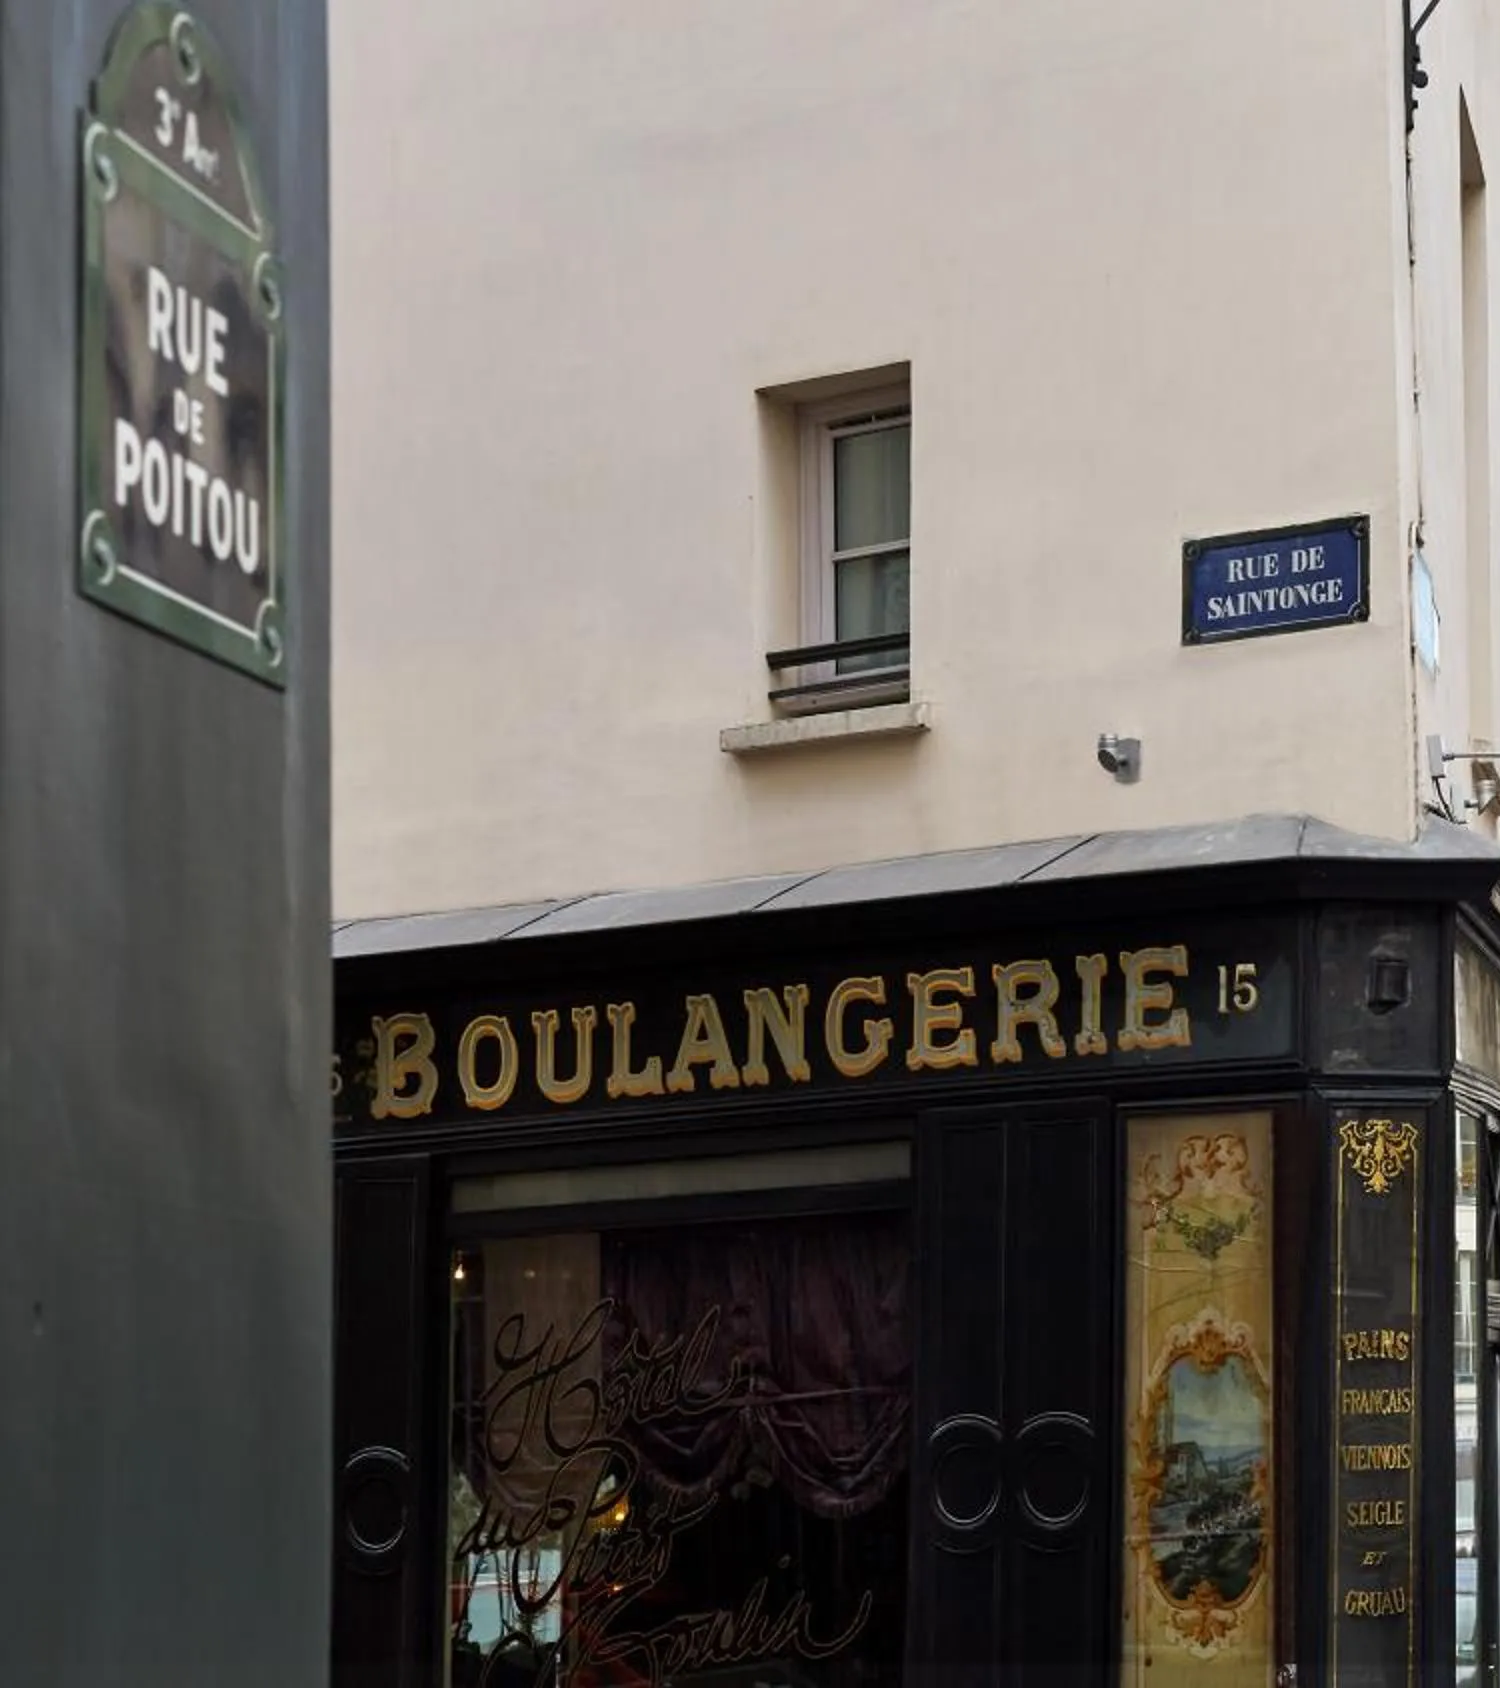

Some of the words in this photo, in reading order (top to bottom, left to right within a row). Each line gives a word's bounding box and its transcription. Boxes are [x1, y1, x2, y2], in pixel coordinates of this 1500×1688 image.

[146, 265, 229, 397] RUE
[173, 388, 205, 444] DE
[115, 418, 260, 575] POITOU
[1227, 553, 1279, 583] RUE
[1292, 546, 1325, 573] DE
[1207, 578, 1343, 621] SAINTONGE
[369, 944, 1192, 1119] BOULANGERIE
[1217, 963, 1259, 1013] 15
[1343, 1329, 1410, 1362] PAINS
[1341, 1444, 1411, 1471] VIENNOIS
[1346, 1501, 1405, 1526] SEIGLE
[1361, 1551, 1387, 1566] ET
[1344, 1587, 1406, 1617] GRUAU
